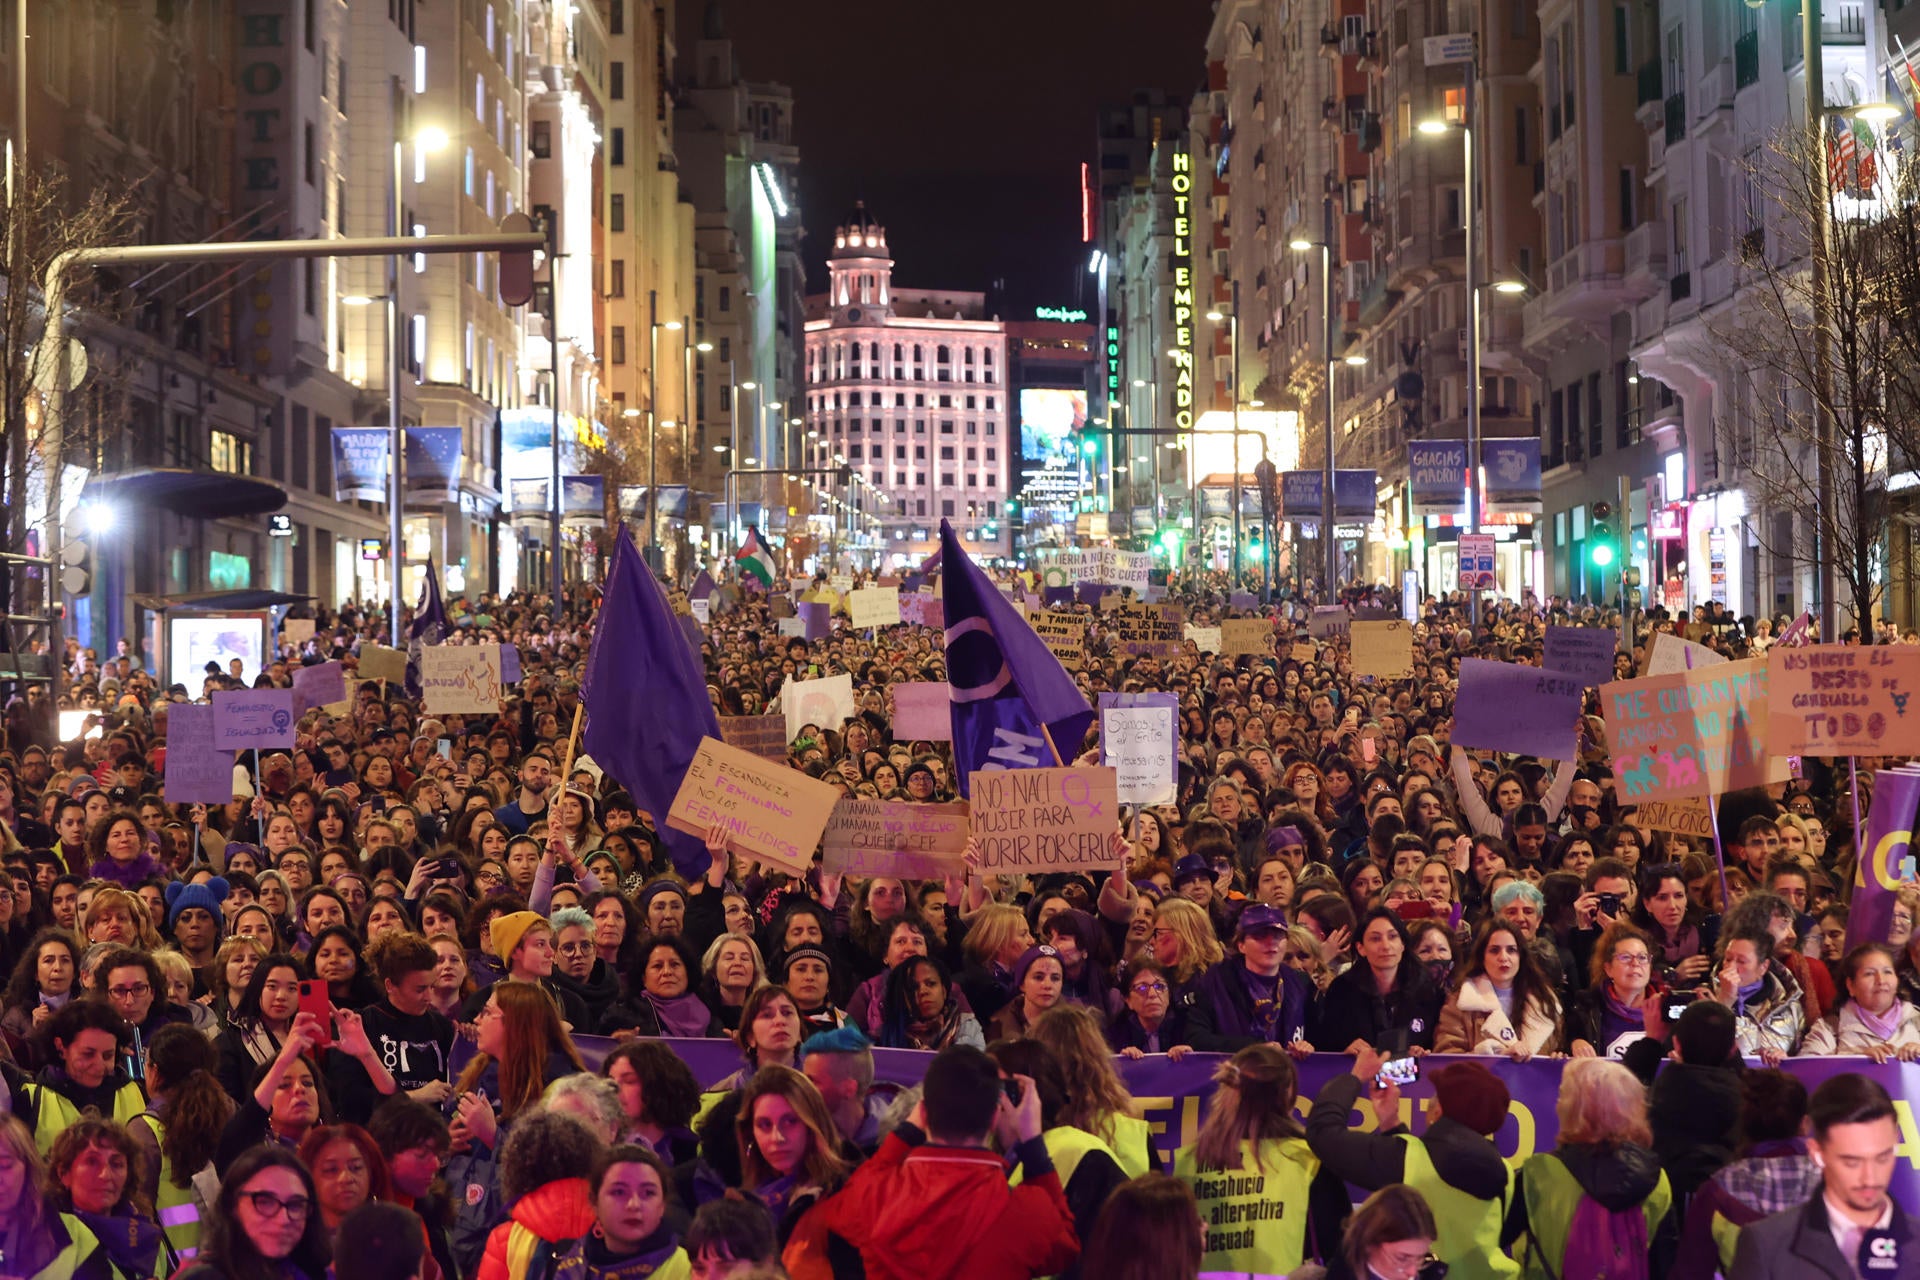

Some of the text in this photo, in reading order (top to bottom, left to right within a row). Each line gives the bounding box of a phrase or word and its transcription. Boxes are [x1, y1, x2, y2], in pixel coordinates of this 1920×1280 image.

[1172, 153, 1193, 451] HOTEL EMPERADOR
[1412, 450, 1462, 466] GRACIAS
[1416, 467, 1460, 484] MADRID
[1030, 612, 1041, 622] MI
[1784, 649, 1894, 671] NOS MUEVE EL
[1811, 669, 1898, 690] DESEO DE
[1614, 667, 1769, 720] ME CUIDAN MIS
[1791, 692, 1869, 708] CAMBIARLO
[1618, 717, 1678, 750] AMIGAS
[1694, 711, 1720, 741] NO
[1805, 712, 1886, 740] TODO
[691, 765, 793, 817] EL FEMINISMO
[697, 786, 738, 810] NO LOS
[978, 778, 1003, 809] NO
[975, 805, 1075, 833] MUJER PARA
[1638, 802, 1668, 825] HASTA
[685, 800, 799, 858] FEMINICIDIOS
[975, 835, 1032, 869] MORIR
[1194, 1173, 1265, 1200] desahucio
[1210, 1198, 1284, 1225] alternativa
